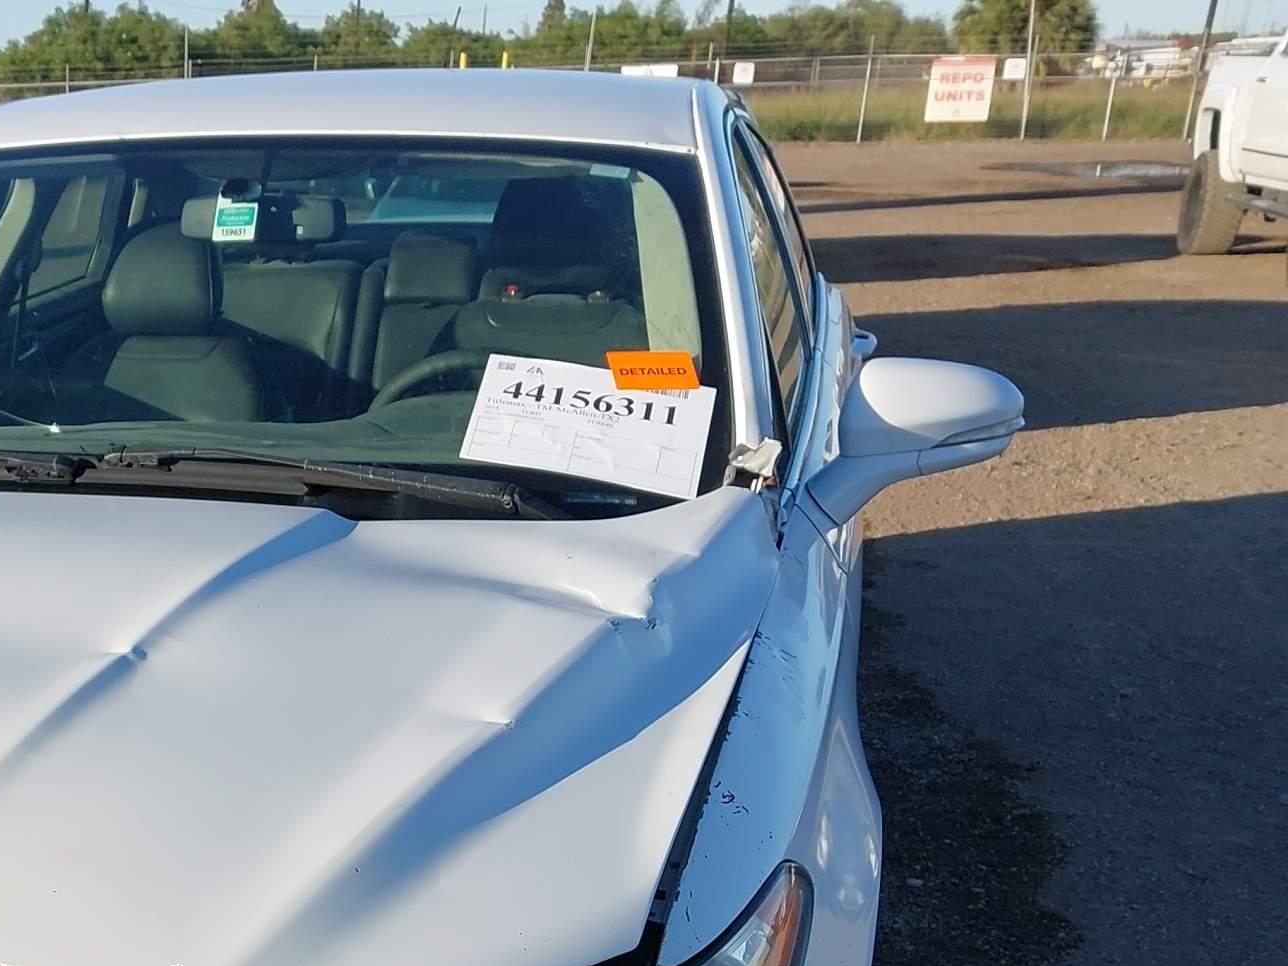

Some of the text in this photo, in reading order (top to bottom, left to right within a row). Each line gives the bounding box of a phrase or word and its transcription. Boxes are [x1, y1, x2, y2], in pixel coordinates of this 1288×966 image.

[939, 72, 985, 84] REPO
[934, 90, 985, 102] UNITS
[619, 367, 687, 376] DETAILED
[502, 380, 678, 426] 44156311
